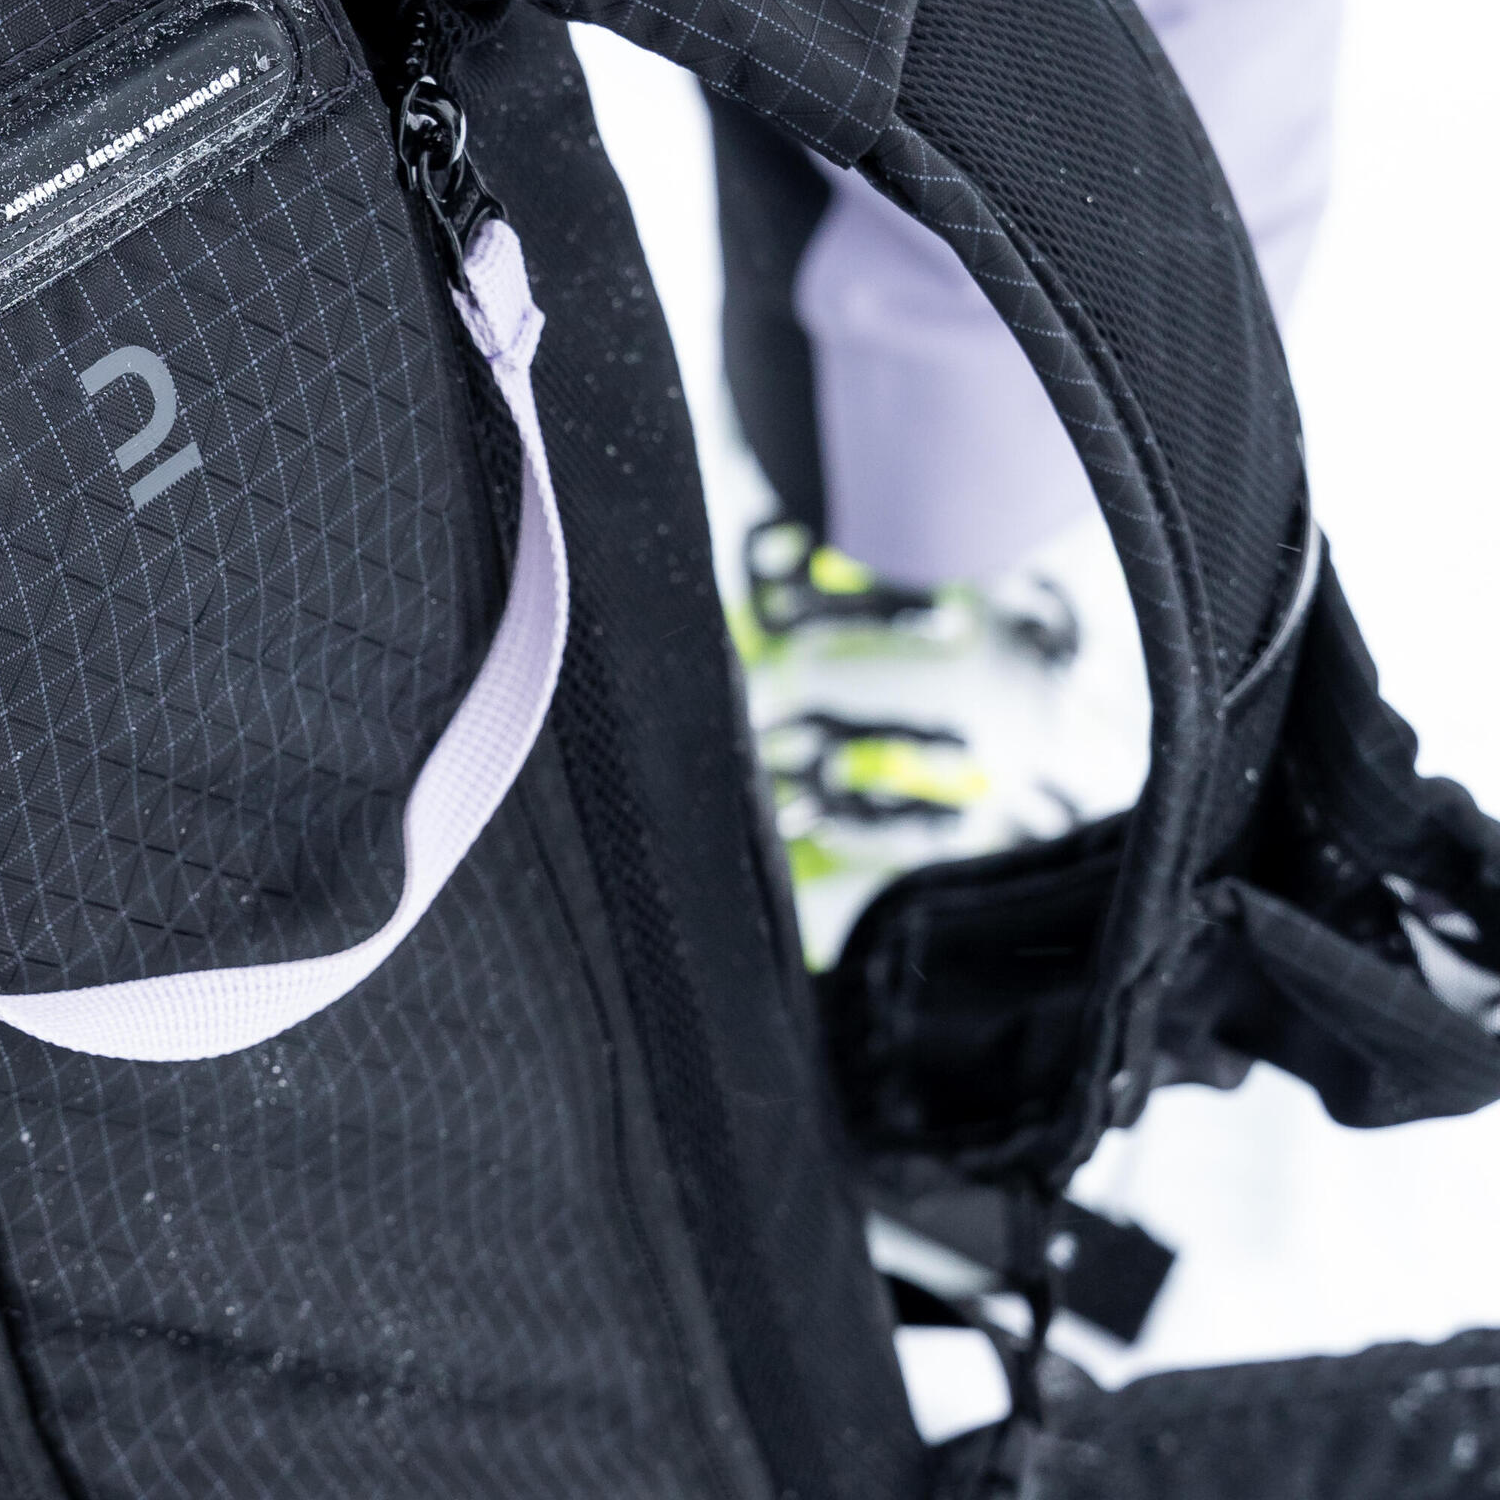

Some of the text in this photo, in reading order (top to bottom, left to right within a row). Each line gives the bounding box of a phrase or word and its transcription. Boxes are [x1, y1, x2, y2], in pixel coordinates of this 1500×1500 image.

[4, 67, 241, 220] ADVANCED RESCUE TECHNOLOGY
